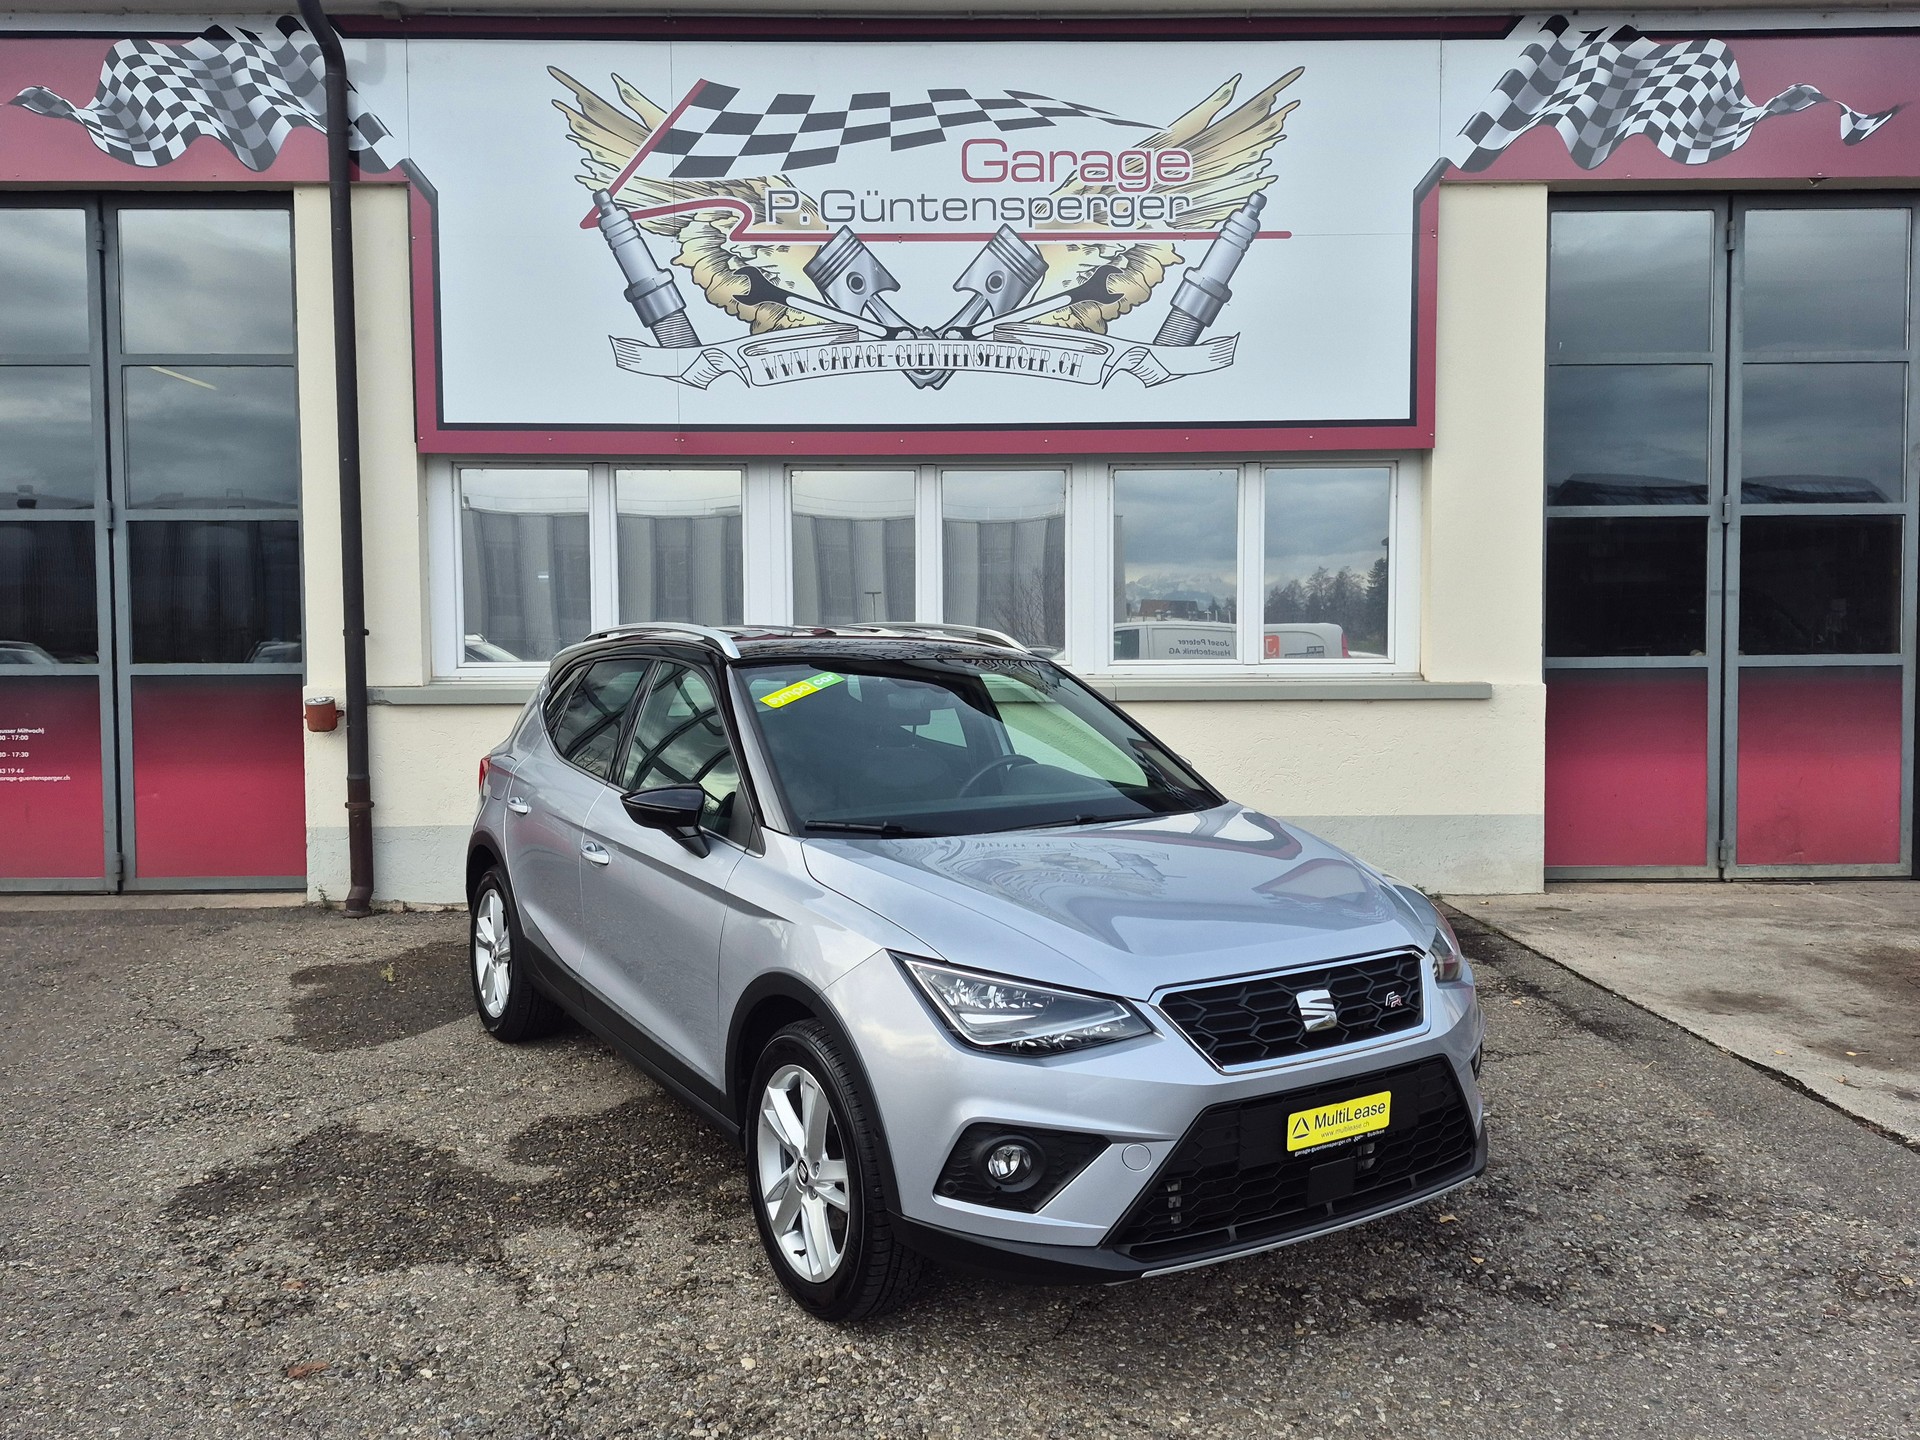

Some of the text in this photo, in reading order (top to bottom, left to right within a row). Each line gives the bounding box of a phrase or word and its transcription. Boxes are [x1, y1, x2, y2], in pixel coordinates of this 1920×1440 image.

[961, 138, 1191, 192] Garage
[761, 343, 1083, 380] WWW.GARAGE-GUENTENSPERGER.CH
[813, 674, 835, 685] car
[1314, 1102, 1386, 1129] MultiLease
